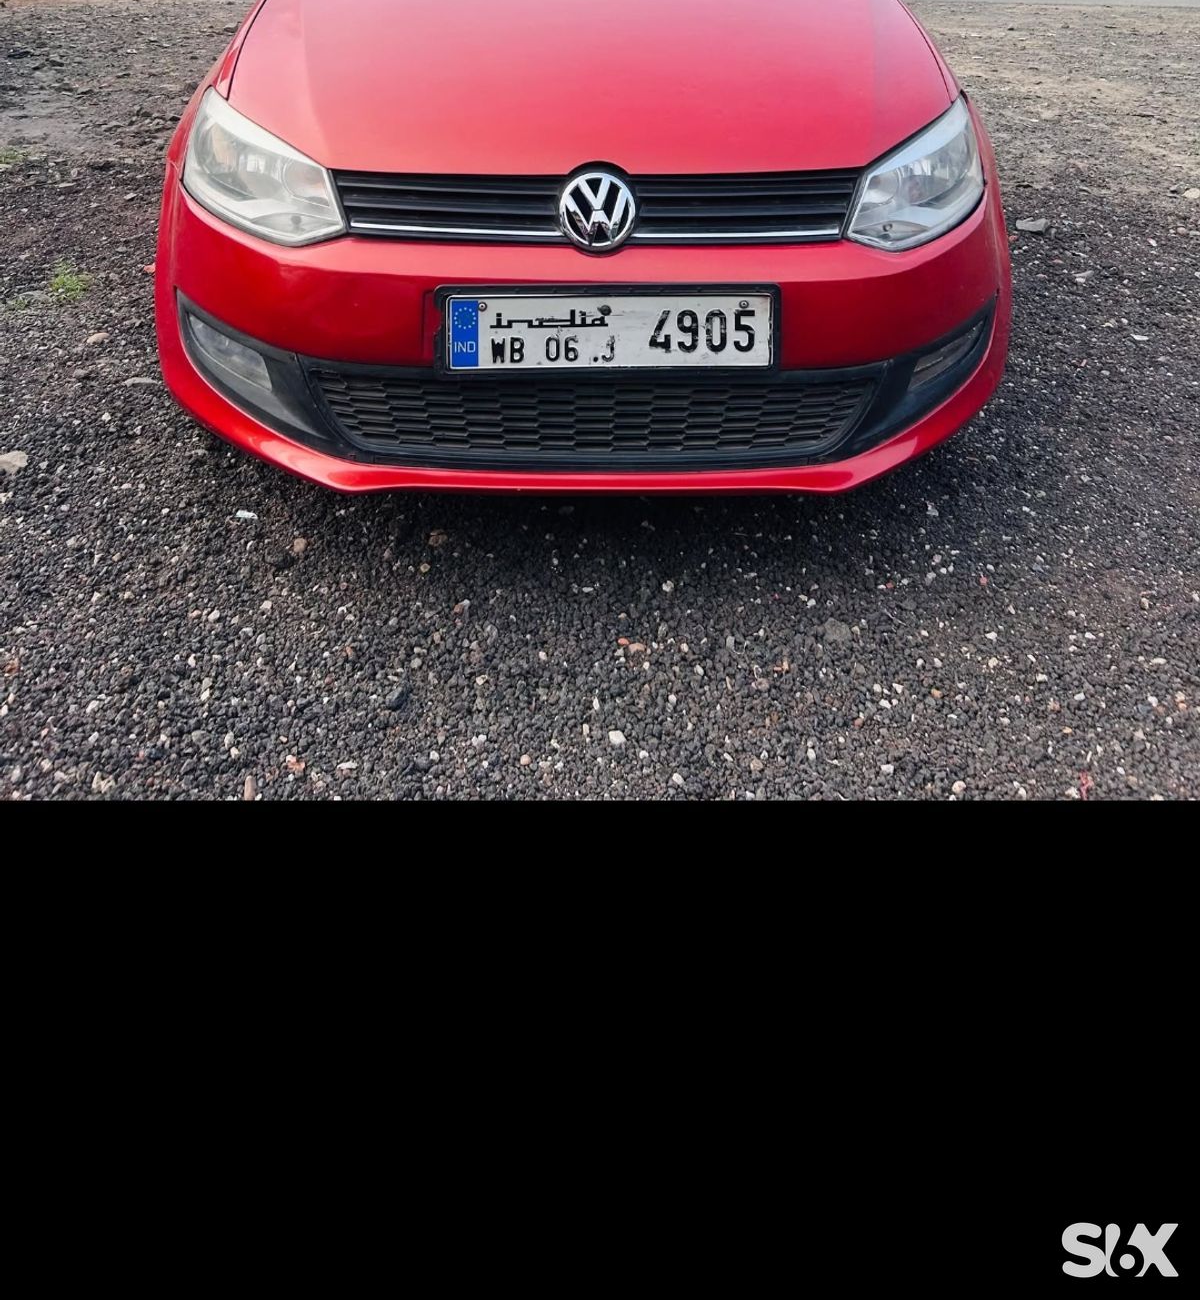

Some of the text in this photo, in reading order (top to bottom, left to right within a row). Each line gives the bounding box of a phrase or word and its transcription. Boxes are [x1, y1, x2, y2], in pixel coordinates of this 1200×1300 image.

[454, 340, 476, 353] IND
[491, 337, 525, 363] WB
[545, 335, 579, 362] 06
[649, 309, 756, 353] 4905
